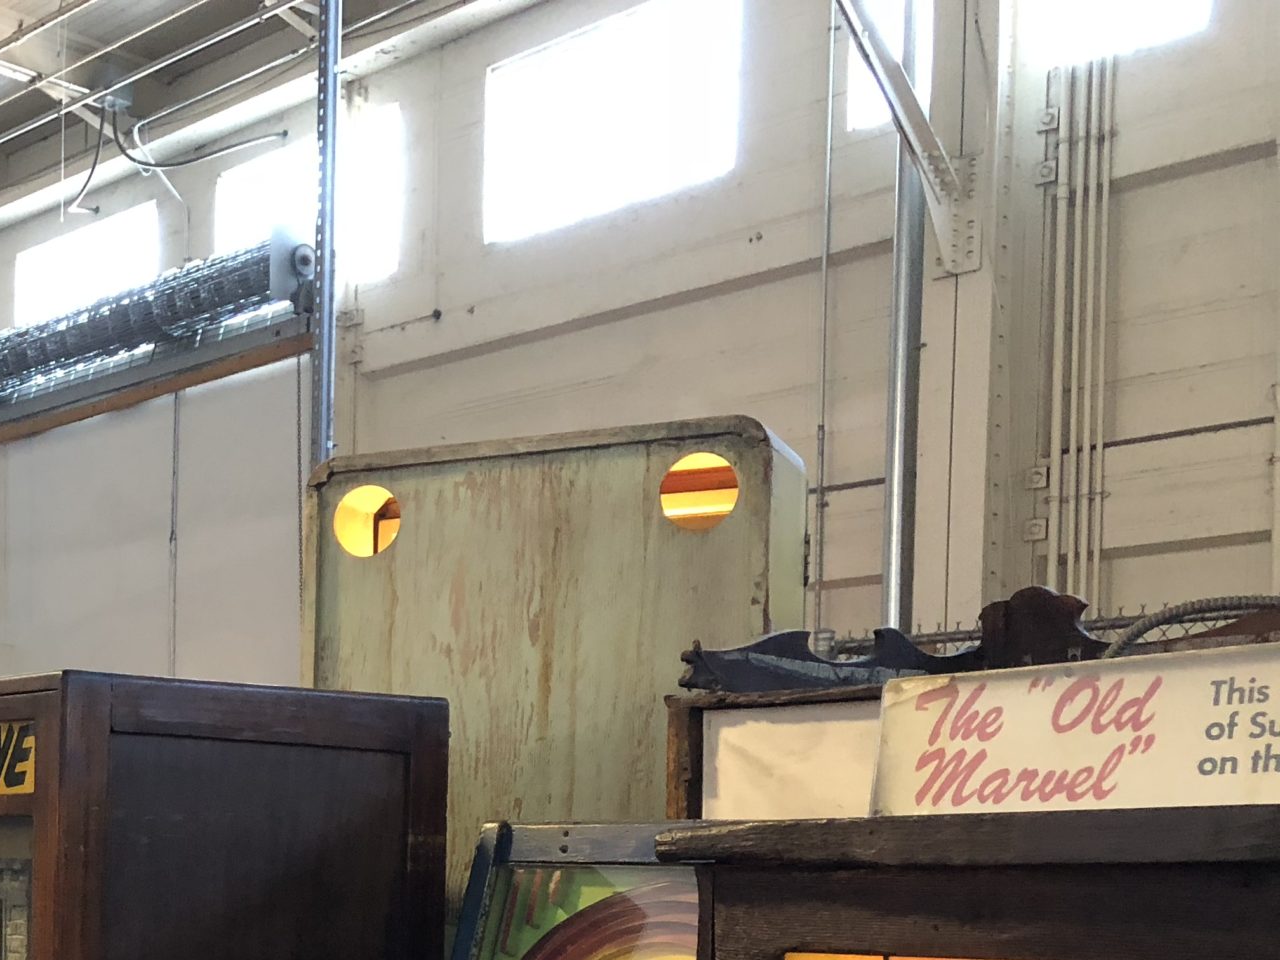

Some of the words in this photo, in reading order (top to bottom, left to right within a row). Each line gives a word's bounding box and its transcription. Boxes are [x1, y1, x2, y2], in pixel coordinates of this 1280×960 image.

[1210, 676, 1270, 706] This
[914, 674, 1005, 747] The
[1205, 711, 1239, 740] of
[1197, 756, 1238, 775] on
